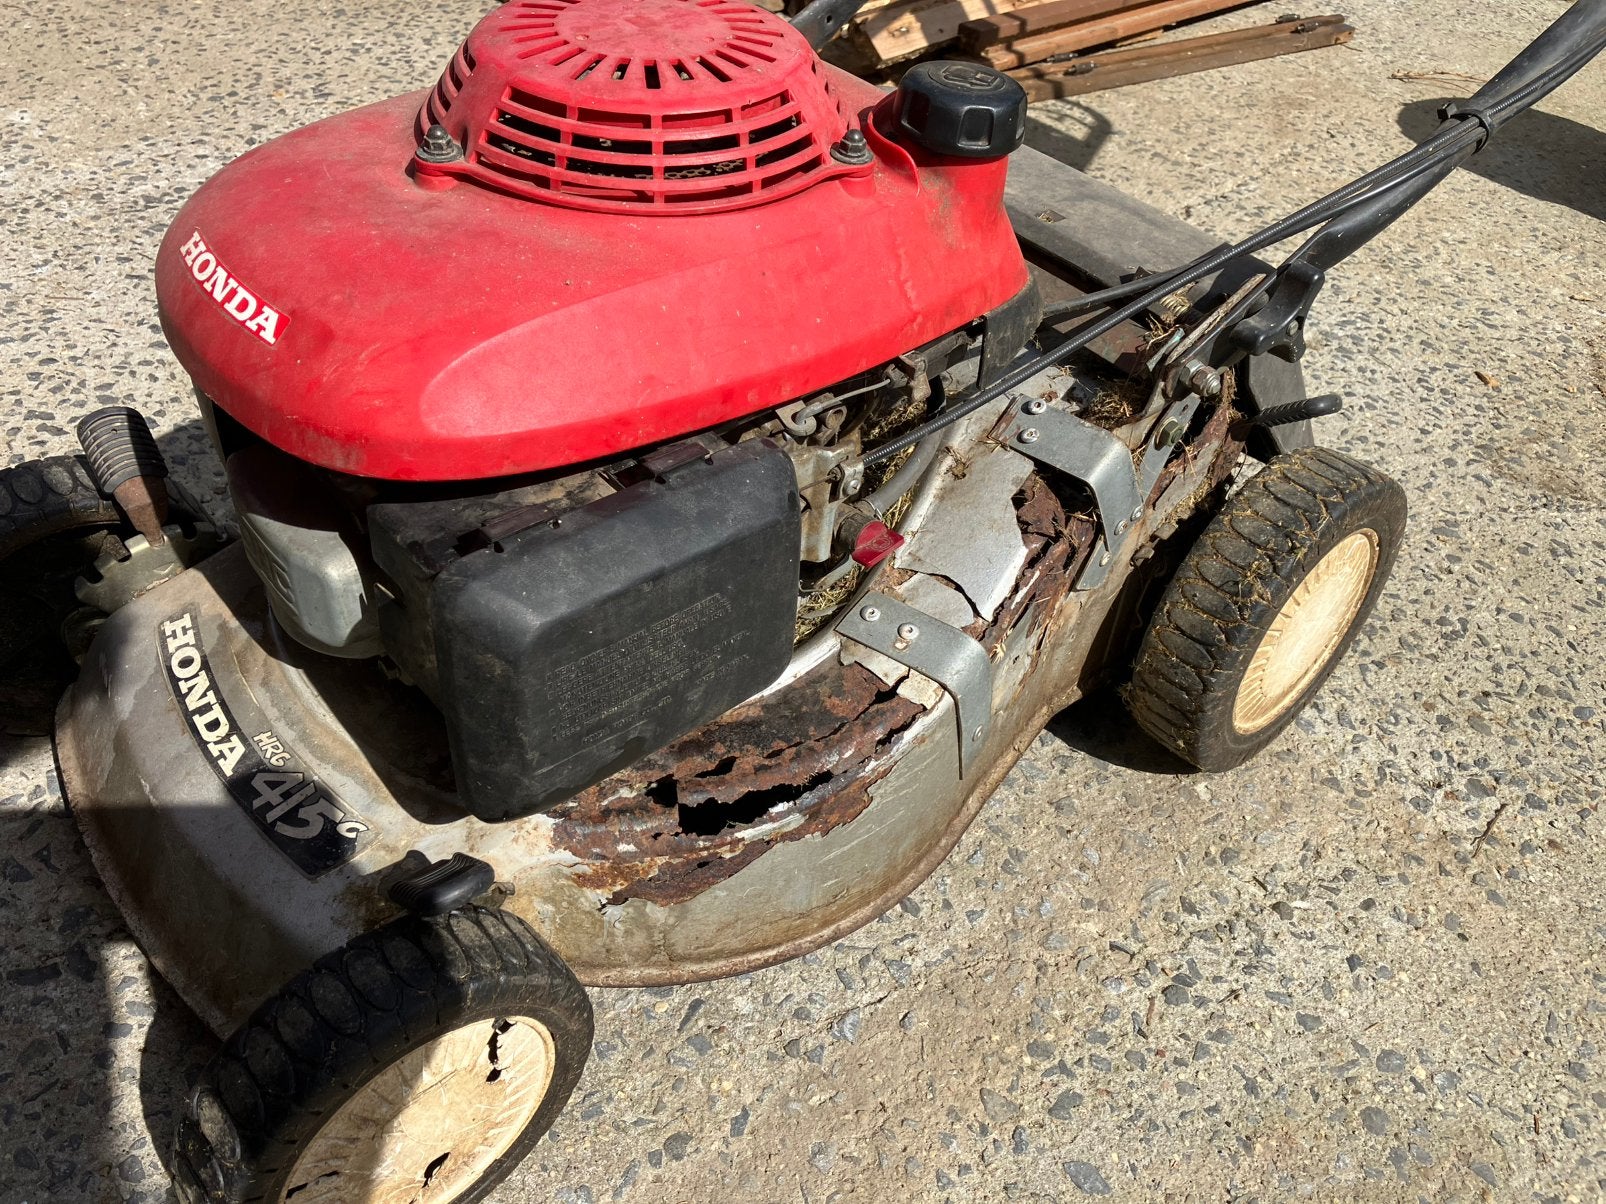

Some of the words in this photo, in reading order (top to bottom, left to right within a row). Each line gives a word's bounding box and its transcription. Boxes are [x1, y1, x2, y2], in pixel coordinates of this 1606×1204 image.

[180, 231, 279, 344] HONDA
[161, 613, 247, 777] HONDA
[252, 731, 293, 767] HRG
